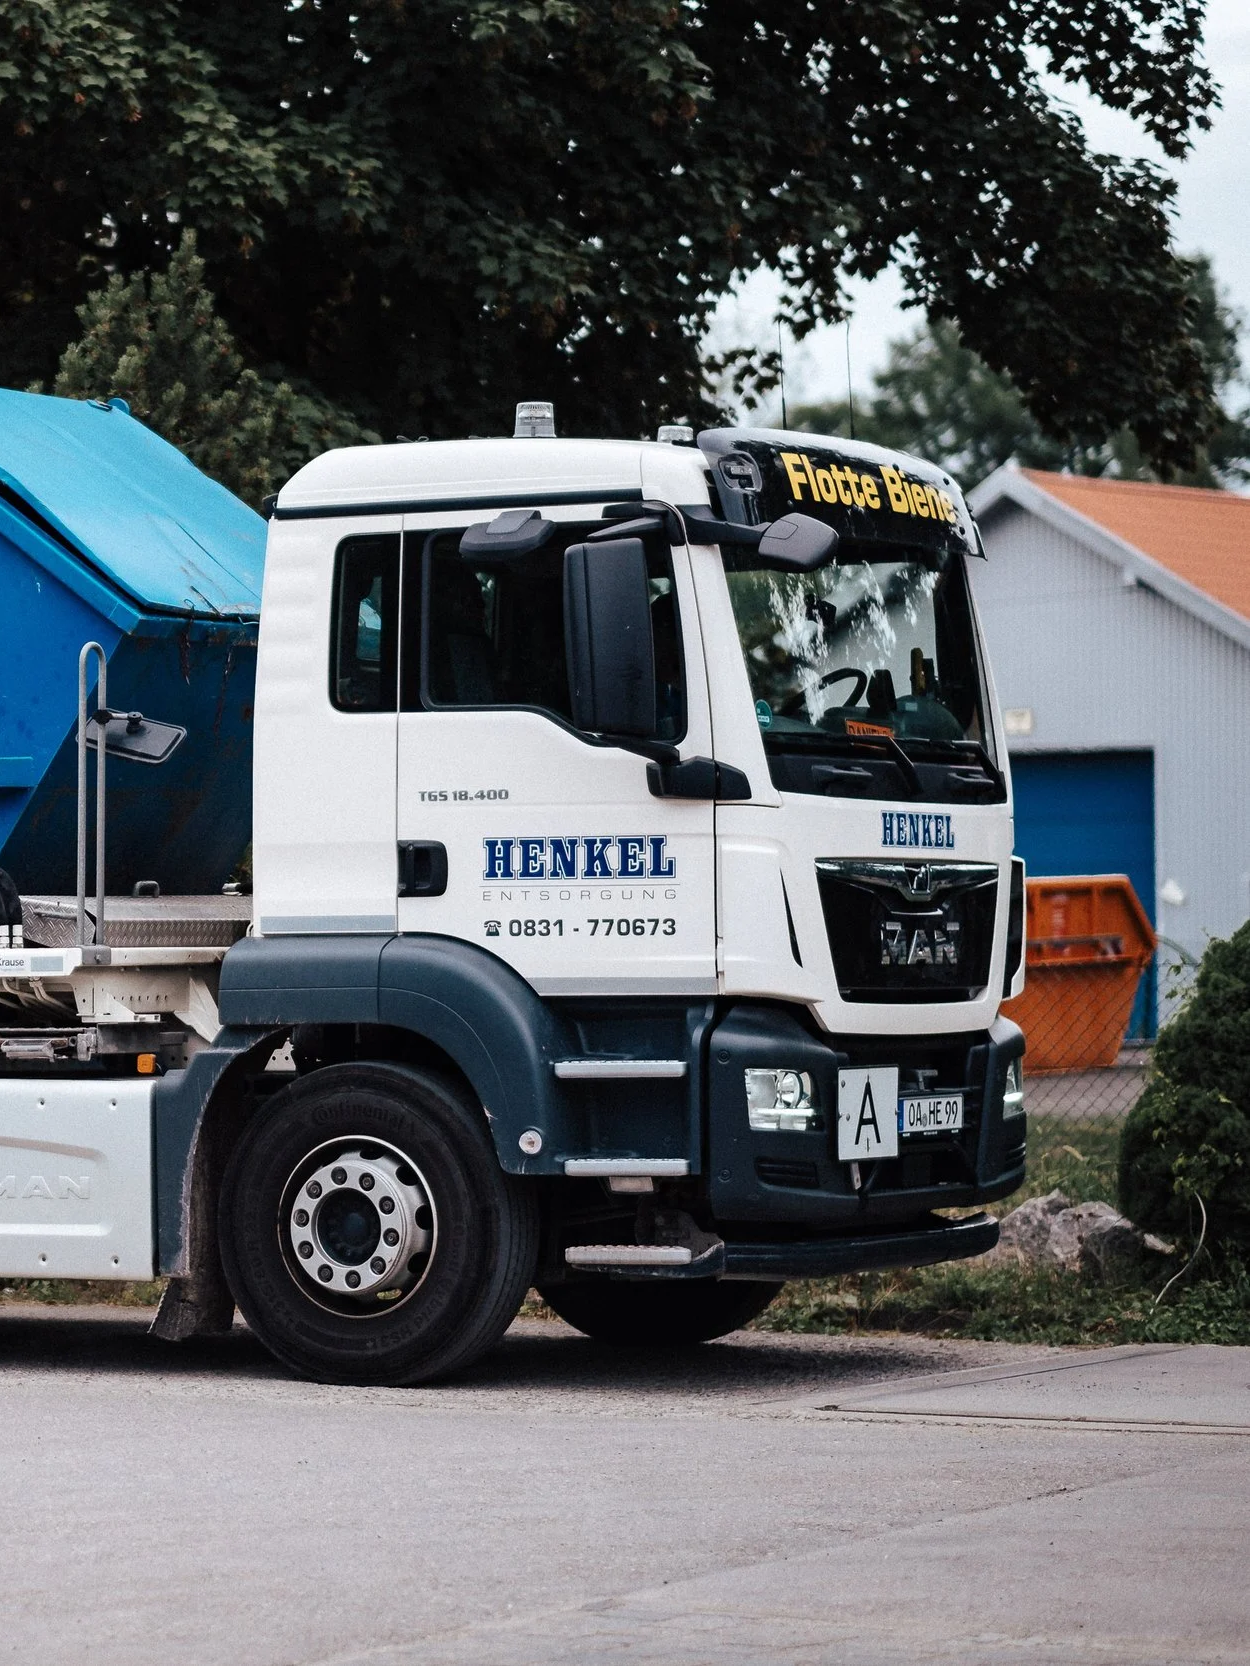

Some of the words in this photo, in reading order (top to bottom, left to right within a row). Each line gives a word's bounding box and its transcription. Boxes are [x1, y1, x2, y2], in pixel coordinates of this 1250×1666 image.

[780, 452, 881, 509] Flotte
[879, 465, 958, 523] Biene
[418, 790, 448, 802] TGS
[452, 789, 509, 801] 18.400
[881, 810, 955, 850] HENKEL
[483, 835, 676, 880] HENKEL
[483, 888, 677, 901] ENTSORGUNG
[509, 919, 564, 936] 0831
[587, 918, 676, 936] 770673
[881, 928, 958, 965] MAN
[855, 1078, 881, 1145] A
[908, 1102, 922, 1126] OA
[928, 1101, 943, 1125] HE
[945, 1101, 959, 1125] 99
